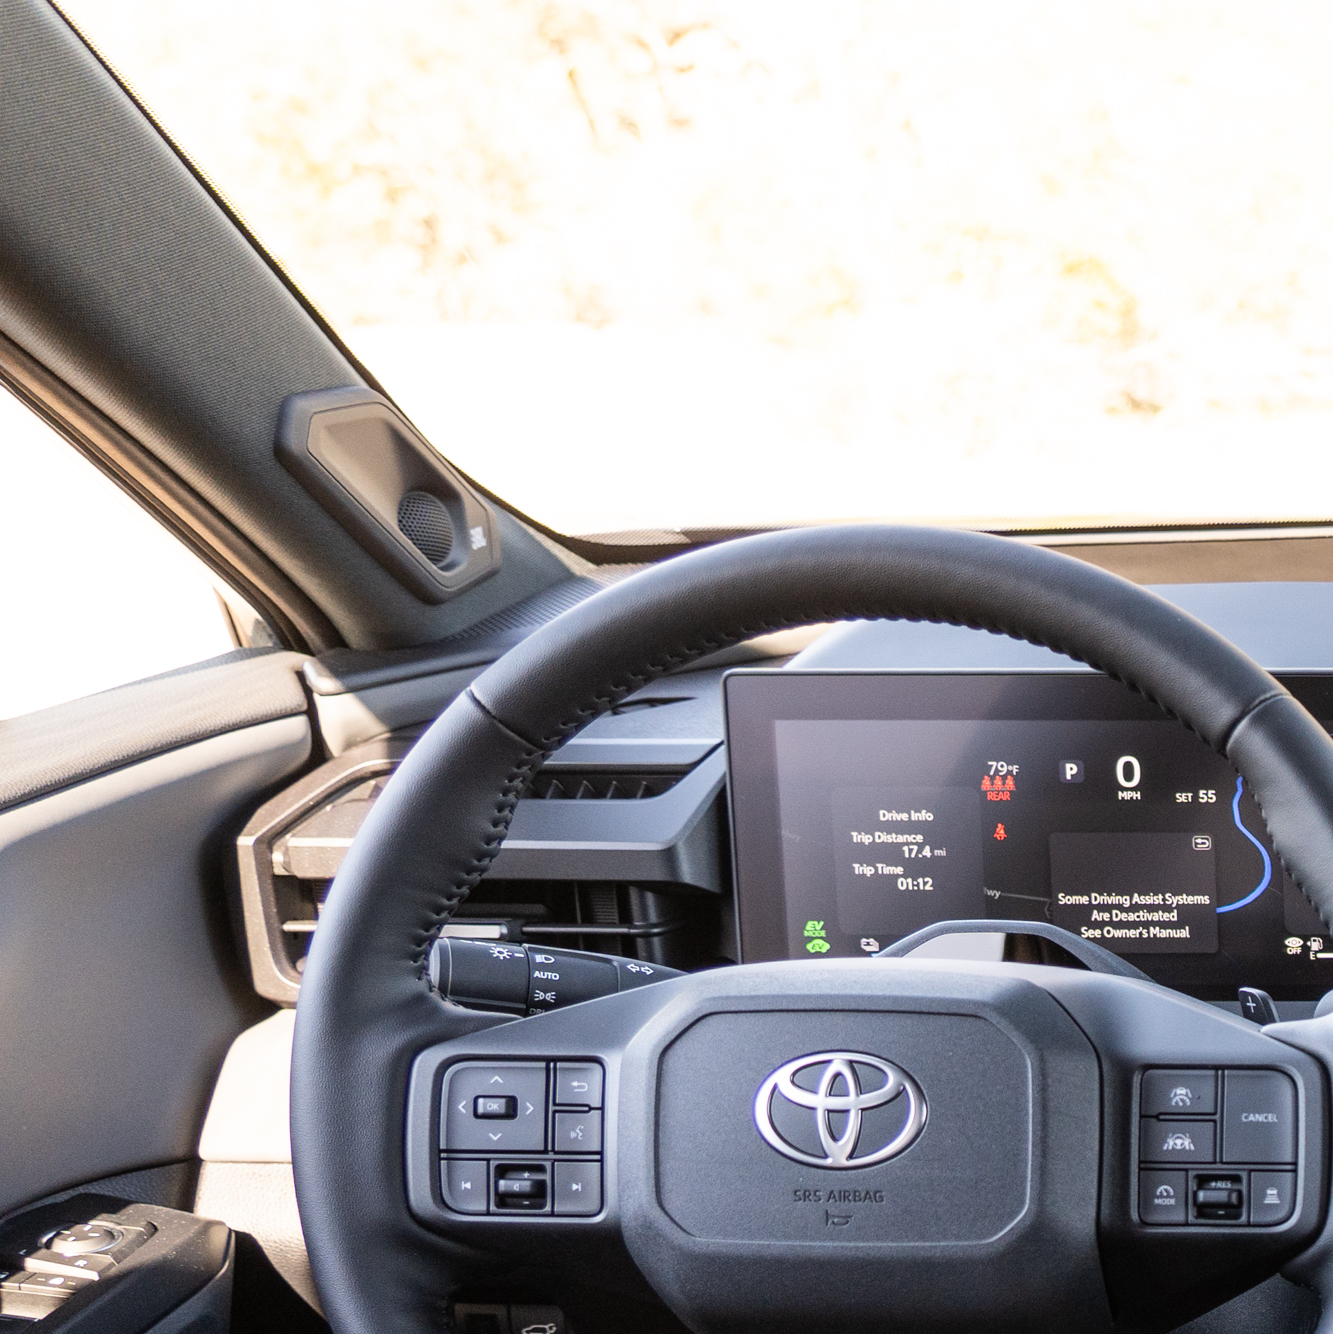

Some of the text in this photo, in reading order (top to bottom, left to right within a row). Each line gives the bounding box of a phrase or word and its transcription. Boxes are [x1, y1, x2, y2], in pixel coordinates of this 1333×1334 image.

[1065, 763, 1078, 779] P
[1115, 756, 1142, 788] 0
[986, 791, 1011, 801] REAR
[1118, 791, 1141, 801] MPH
[1176, 790, 1217, 803] SET 55
[879, 810, 934, 821] Drive Info
[851, 832, 923, 845] Trip Distance
[902, 846, 946, 859] 17.4 mi
[853, 864, 904, 877] Trip Time
[897, 878, 933, 891] 01:12
[1058, 893, 1210, 907] Some Driving Assist Systems
[1091, 910, 1178, 921] Are Deactivated
[805, 920, 825, 931] EV
[803, 930, 827, 938] MODE
[1081, 927, 1102, 938] See
[1150, 926, 1191, 938] Manual
[1286, 947, 1302, 955] OFF
[1310, 951, 1316, 960] E
[534, 970, 560, 981] AUTO
[486, 1102, 500, 1110] OK
[1241, 1112, 1278, 1124] CANCEL
[793, 1189, 885, 1203] SRS AIRBAG
[1154, 1196, 1176, 1206] MODE
